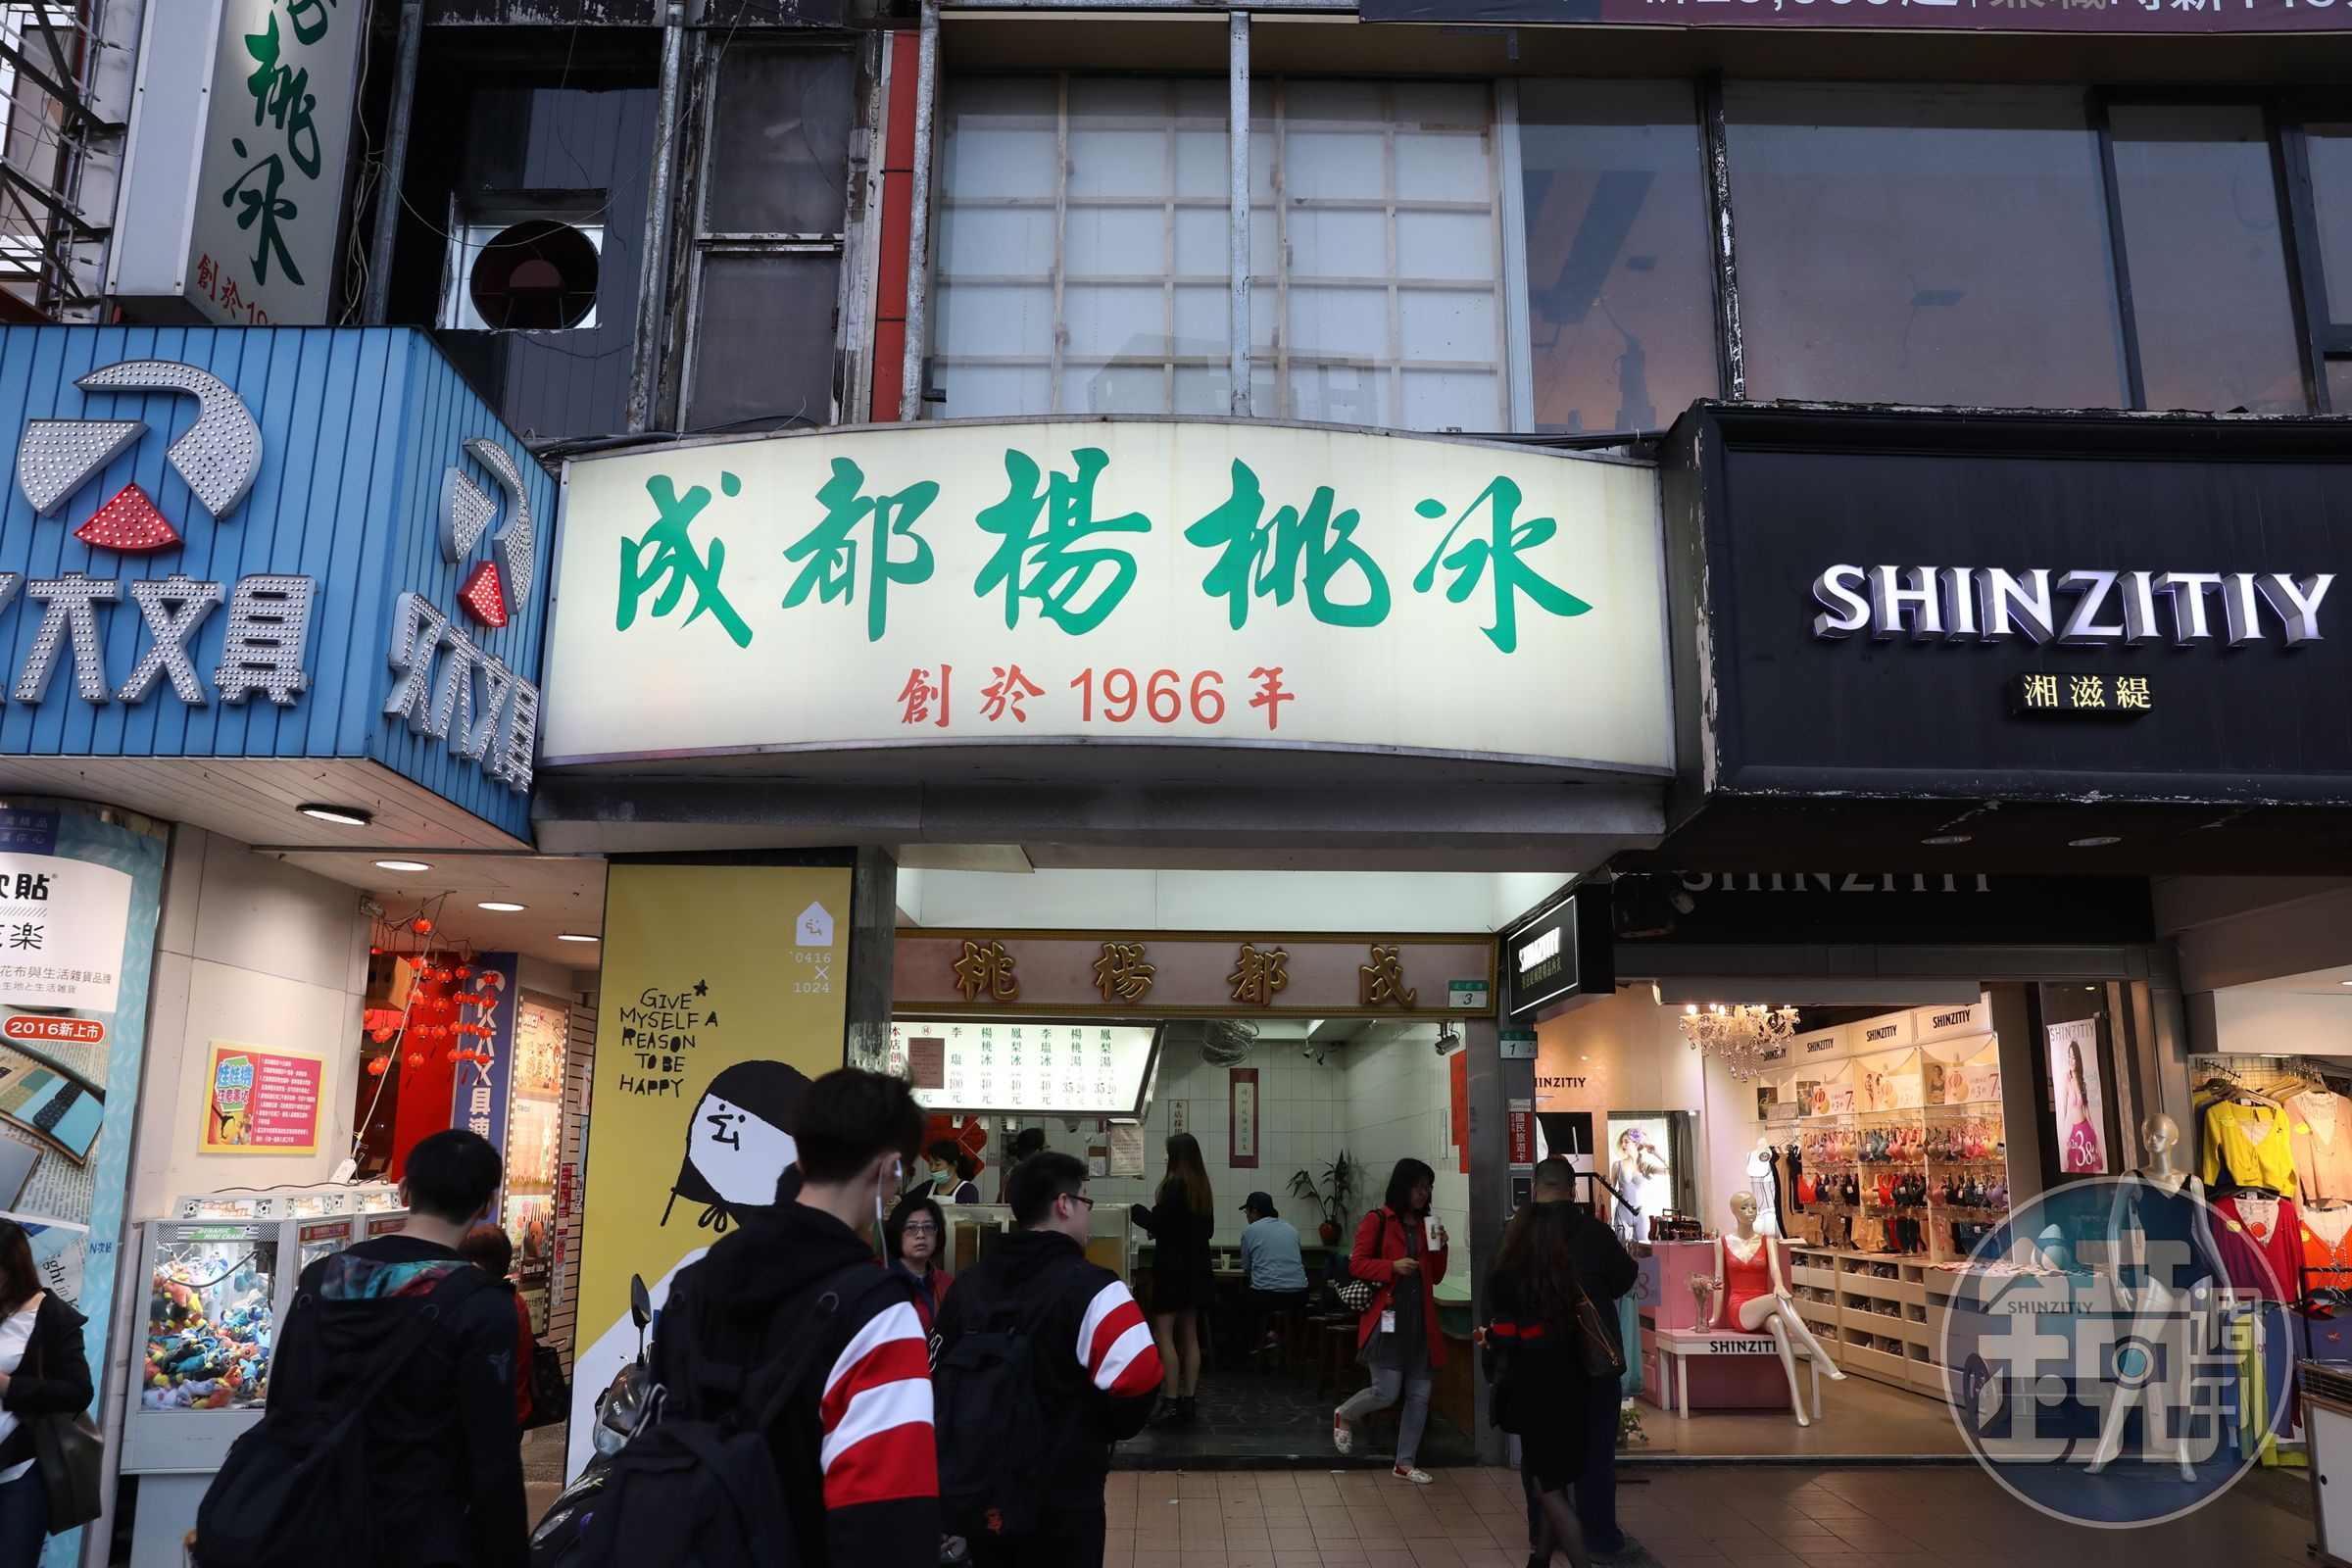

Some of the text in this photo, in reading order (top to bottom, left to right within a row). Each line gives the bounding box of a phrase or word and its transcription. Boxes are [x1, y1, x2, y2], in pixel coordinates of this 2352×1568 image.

[614, 447, 1593, 654] 成都楊桃冰
[1812, 564, 2337, 646] SHINZITIY
[2024, 674, 2152, 710] 湘滋緹
[794, 981, 830, 993] 1024
[640, 988, 692, 1009] GIVE
[1463, 993, 1473, 1005] 3
[620, 1006, 717, 1031] MYSELF A
[1933, 1009, 1971, 1029] SHINZITIY
[10, 1021, 100, 1039] 2016新上市
[621, 1026, 695, 1054] REASON
[1867, 1025, 1897, 1042] SHINZITIY
[2050, 1022, 2095, 1041] SHINZITIY
[981, 1027, 993, 1066] 楊桃冰
[1807, 1038, 1835, 1053] SHINZITIY
[634, 1053, 685, 1072] TO BE
[619, 1074, 684, 1098] HAPPY
[2007, 1300, 2093, 1315] SHINZITIY
